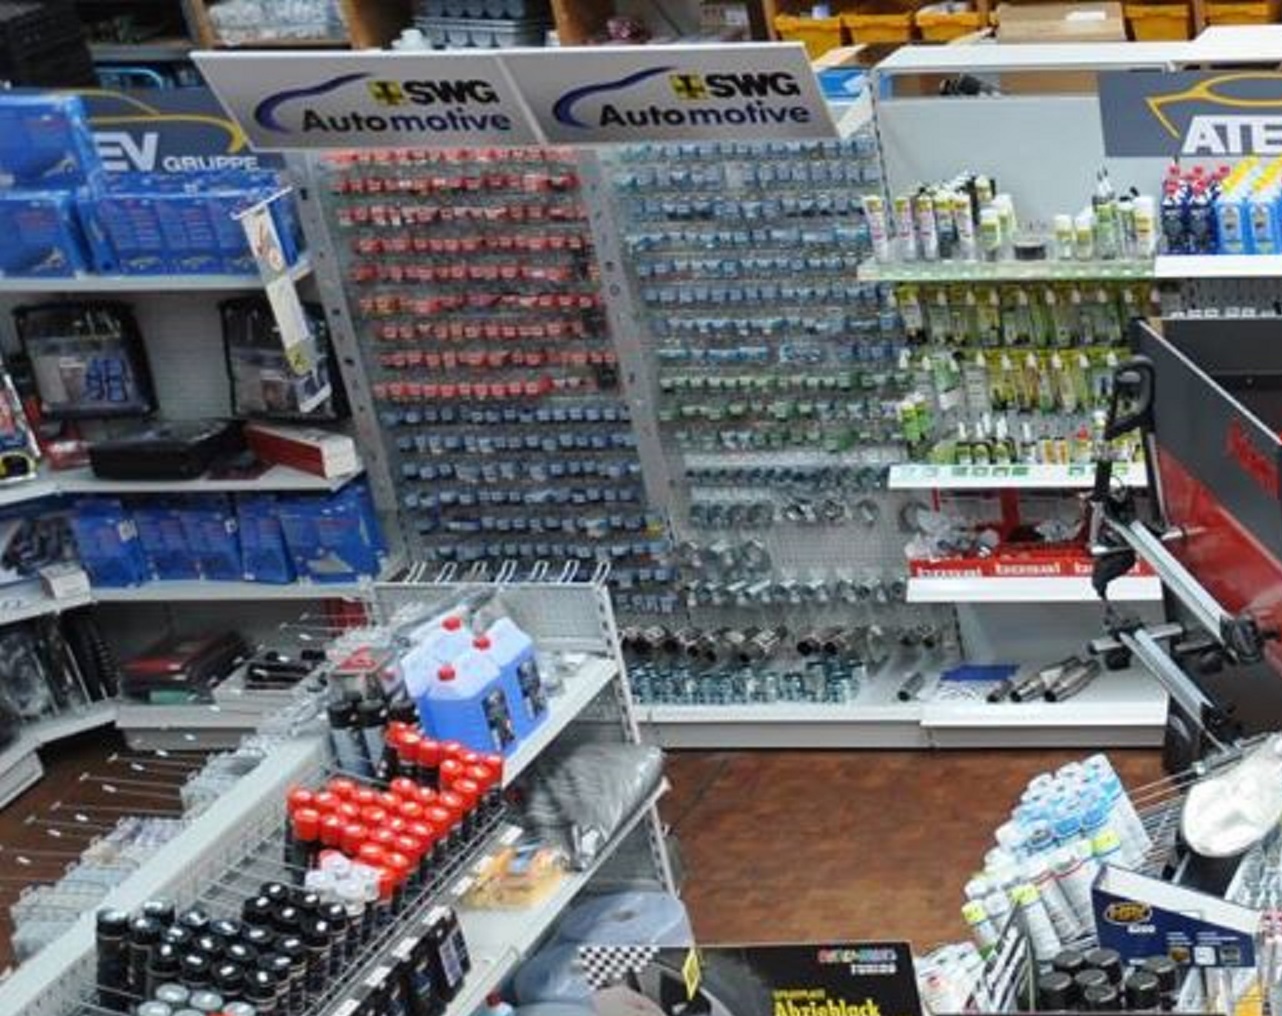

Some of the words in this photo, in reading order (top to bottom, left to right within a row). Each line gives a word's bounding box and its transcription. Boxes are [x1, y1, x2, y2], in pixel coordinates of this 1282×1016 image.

[403, 79, 500, 105] SWG
[704, 72, 801, 98] SWG
[302, 108, 513, 133] Automotive
[599, 101, 810, 127] Automotive
[93, 131, 160, 171] EV
[162, 155, 260, 172] GRUPPE
